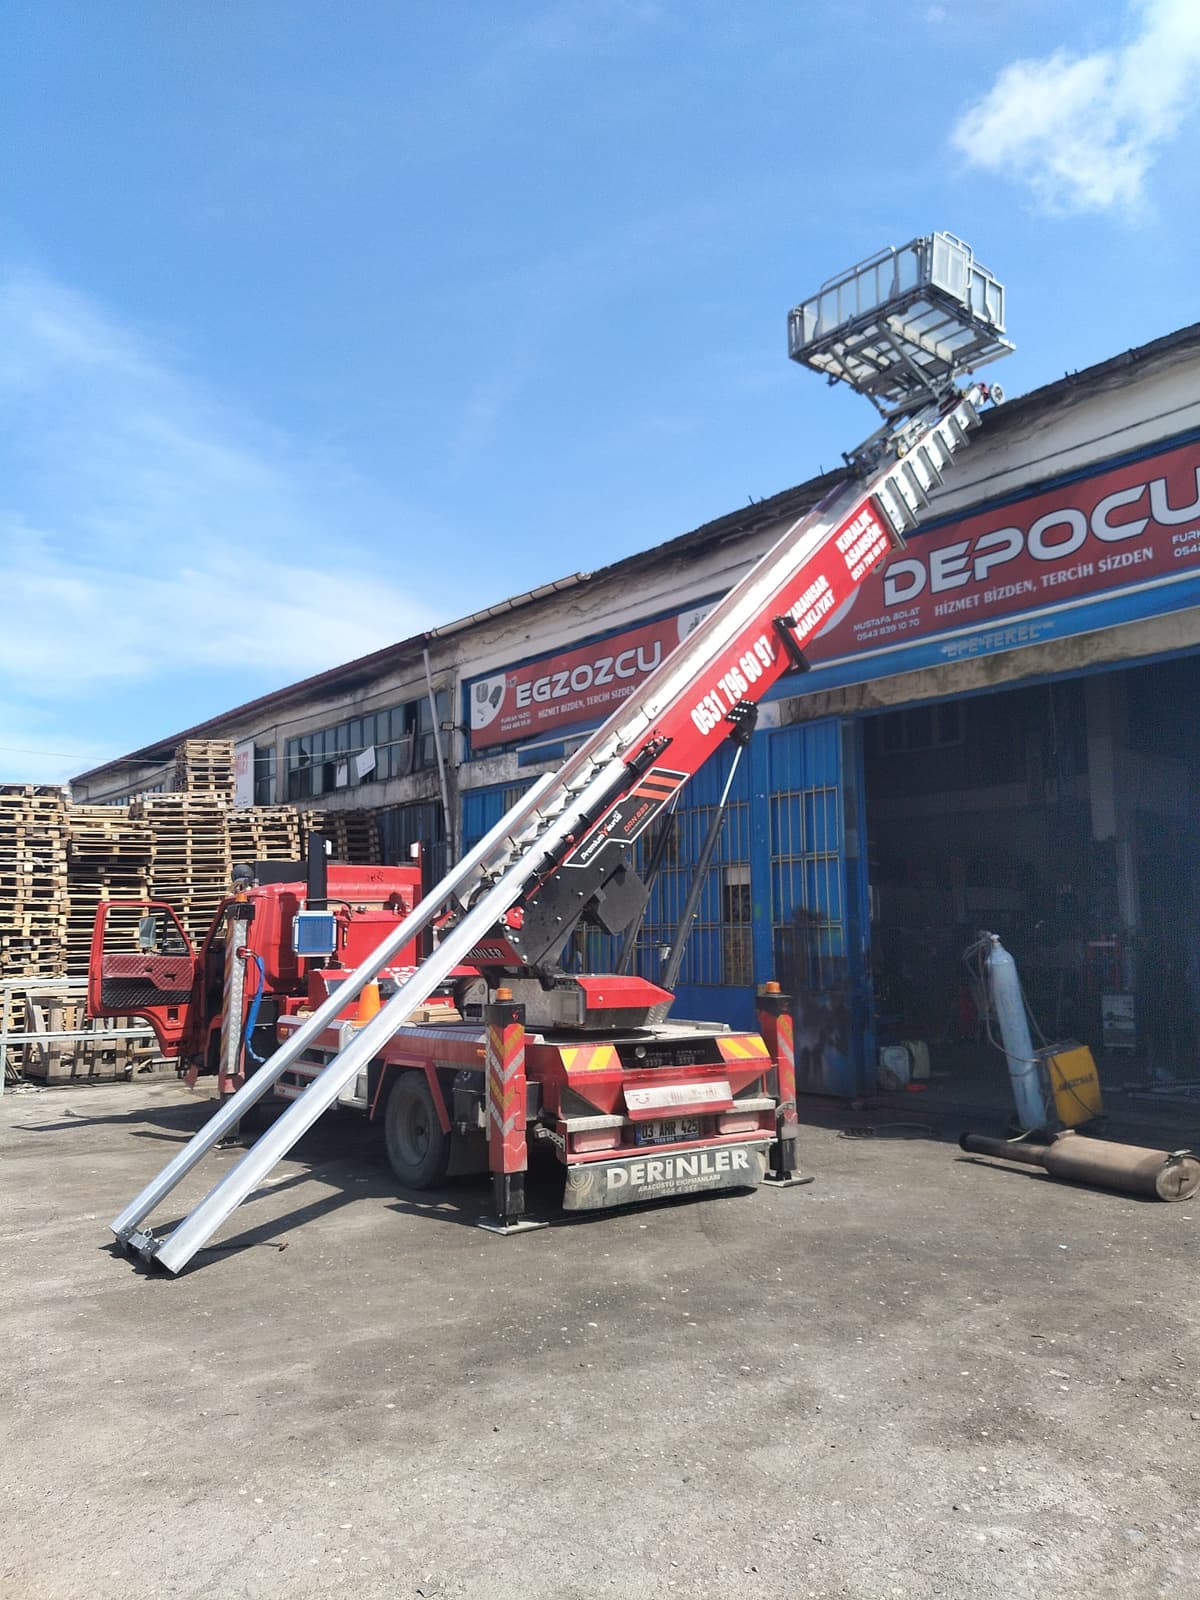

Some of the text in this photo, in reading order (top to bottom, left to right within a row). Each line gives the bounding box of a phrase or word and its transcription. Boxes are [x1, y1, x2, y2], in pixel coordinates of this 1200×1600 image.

[835, 509, 873, 554] KIRALIK
[884, 467, 1200, 608] DEPOCU
[1172, 529, 1200, 545] FUR
[1174, 543, 1200, 557] 054
[935, 547, 1153, 617] HİZMET BİZDEN, TERCİH SİZDEN
[853, 615, 891, 632] MUSTAFA
[515, 640, 662, 708] EGZOZCU
[690, 634, 776, 736] 0531 796 60 97
[642, 1119, 698, 1139] 03 AHR 425
